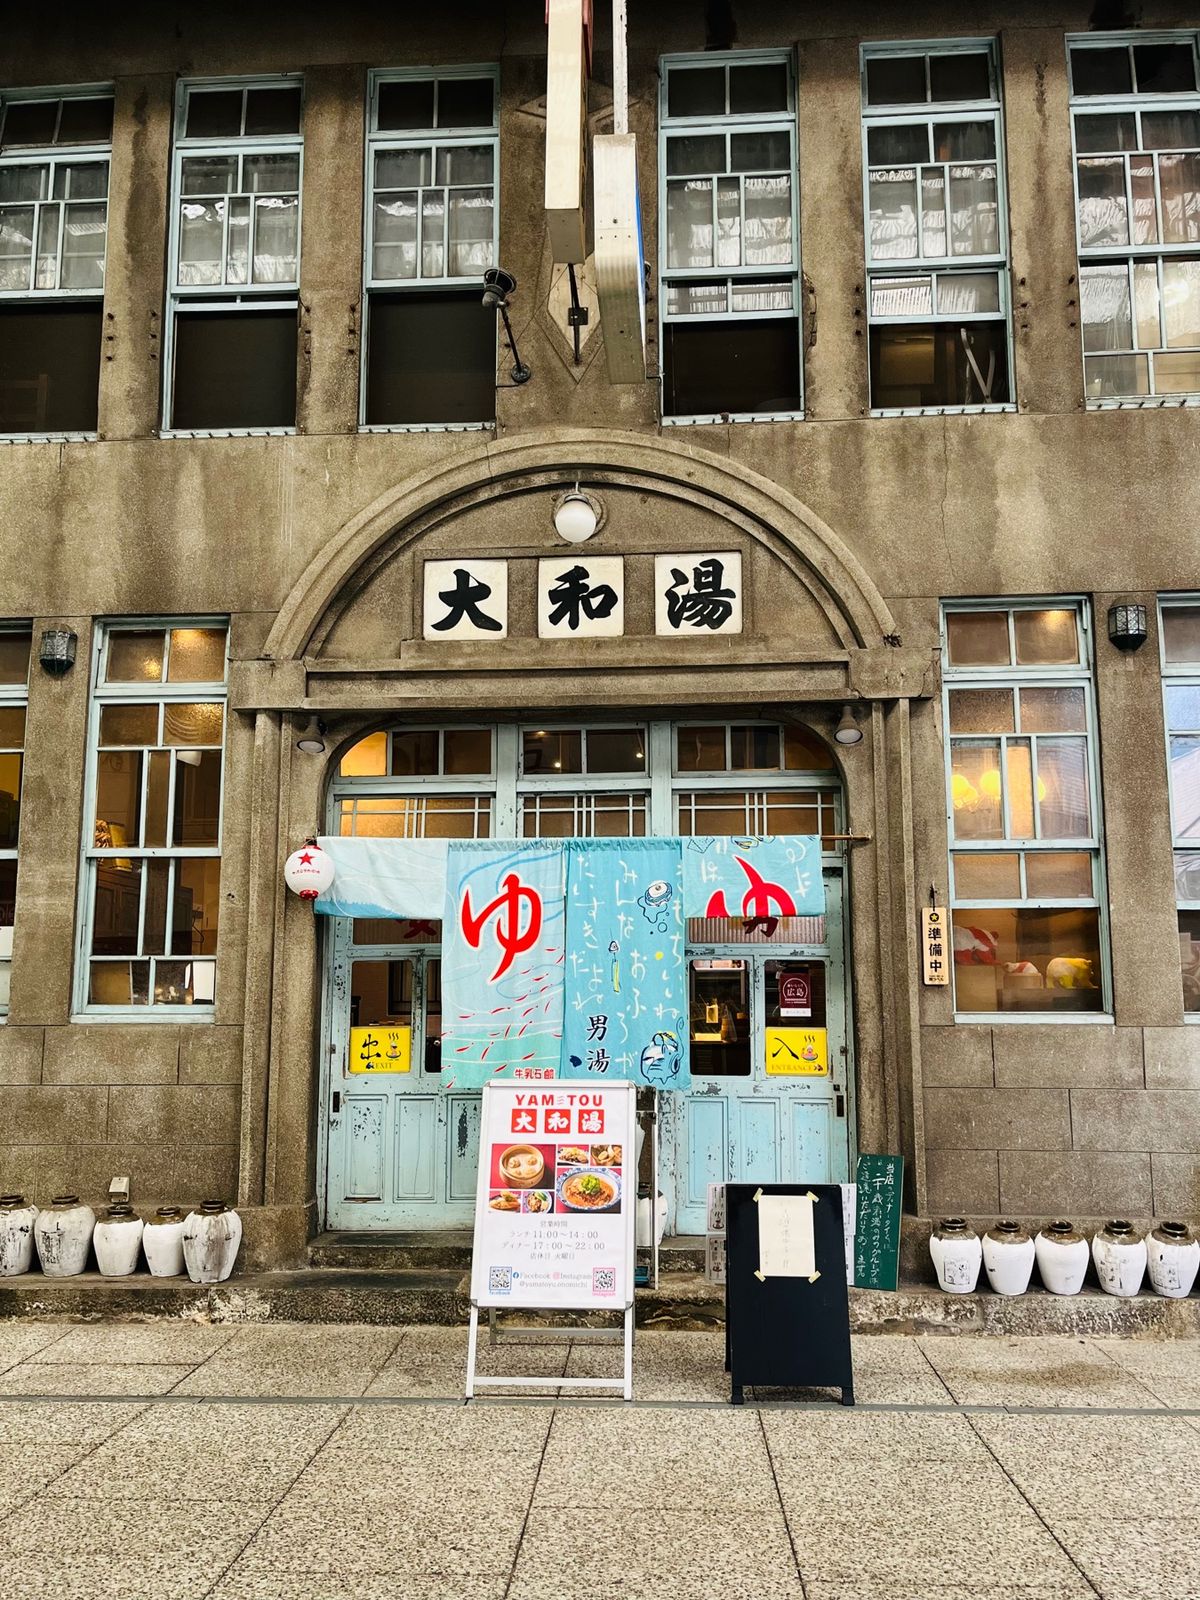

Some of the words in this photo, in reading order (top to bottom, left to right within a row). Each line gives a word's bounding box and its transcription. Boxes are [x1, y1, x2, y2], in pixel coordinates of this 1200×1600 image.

[431, 558, 736, 632] 大和湯
[460, 872, 542, 983] ゆ
[928, 928, 943, 973] 準備中
[787, 988, 804, 997] 広島
[360, 1033, 382, 1060] 出
[586, 1014, 611, 1073] 男湯
[772, 1037, 799, 1060] 入
[513, 1111, 603, 1132] 大和湯
[520, 1271, 550, 1279] Facebook
[561, 1271, 592, 1281] Instagram
